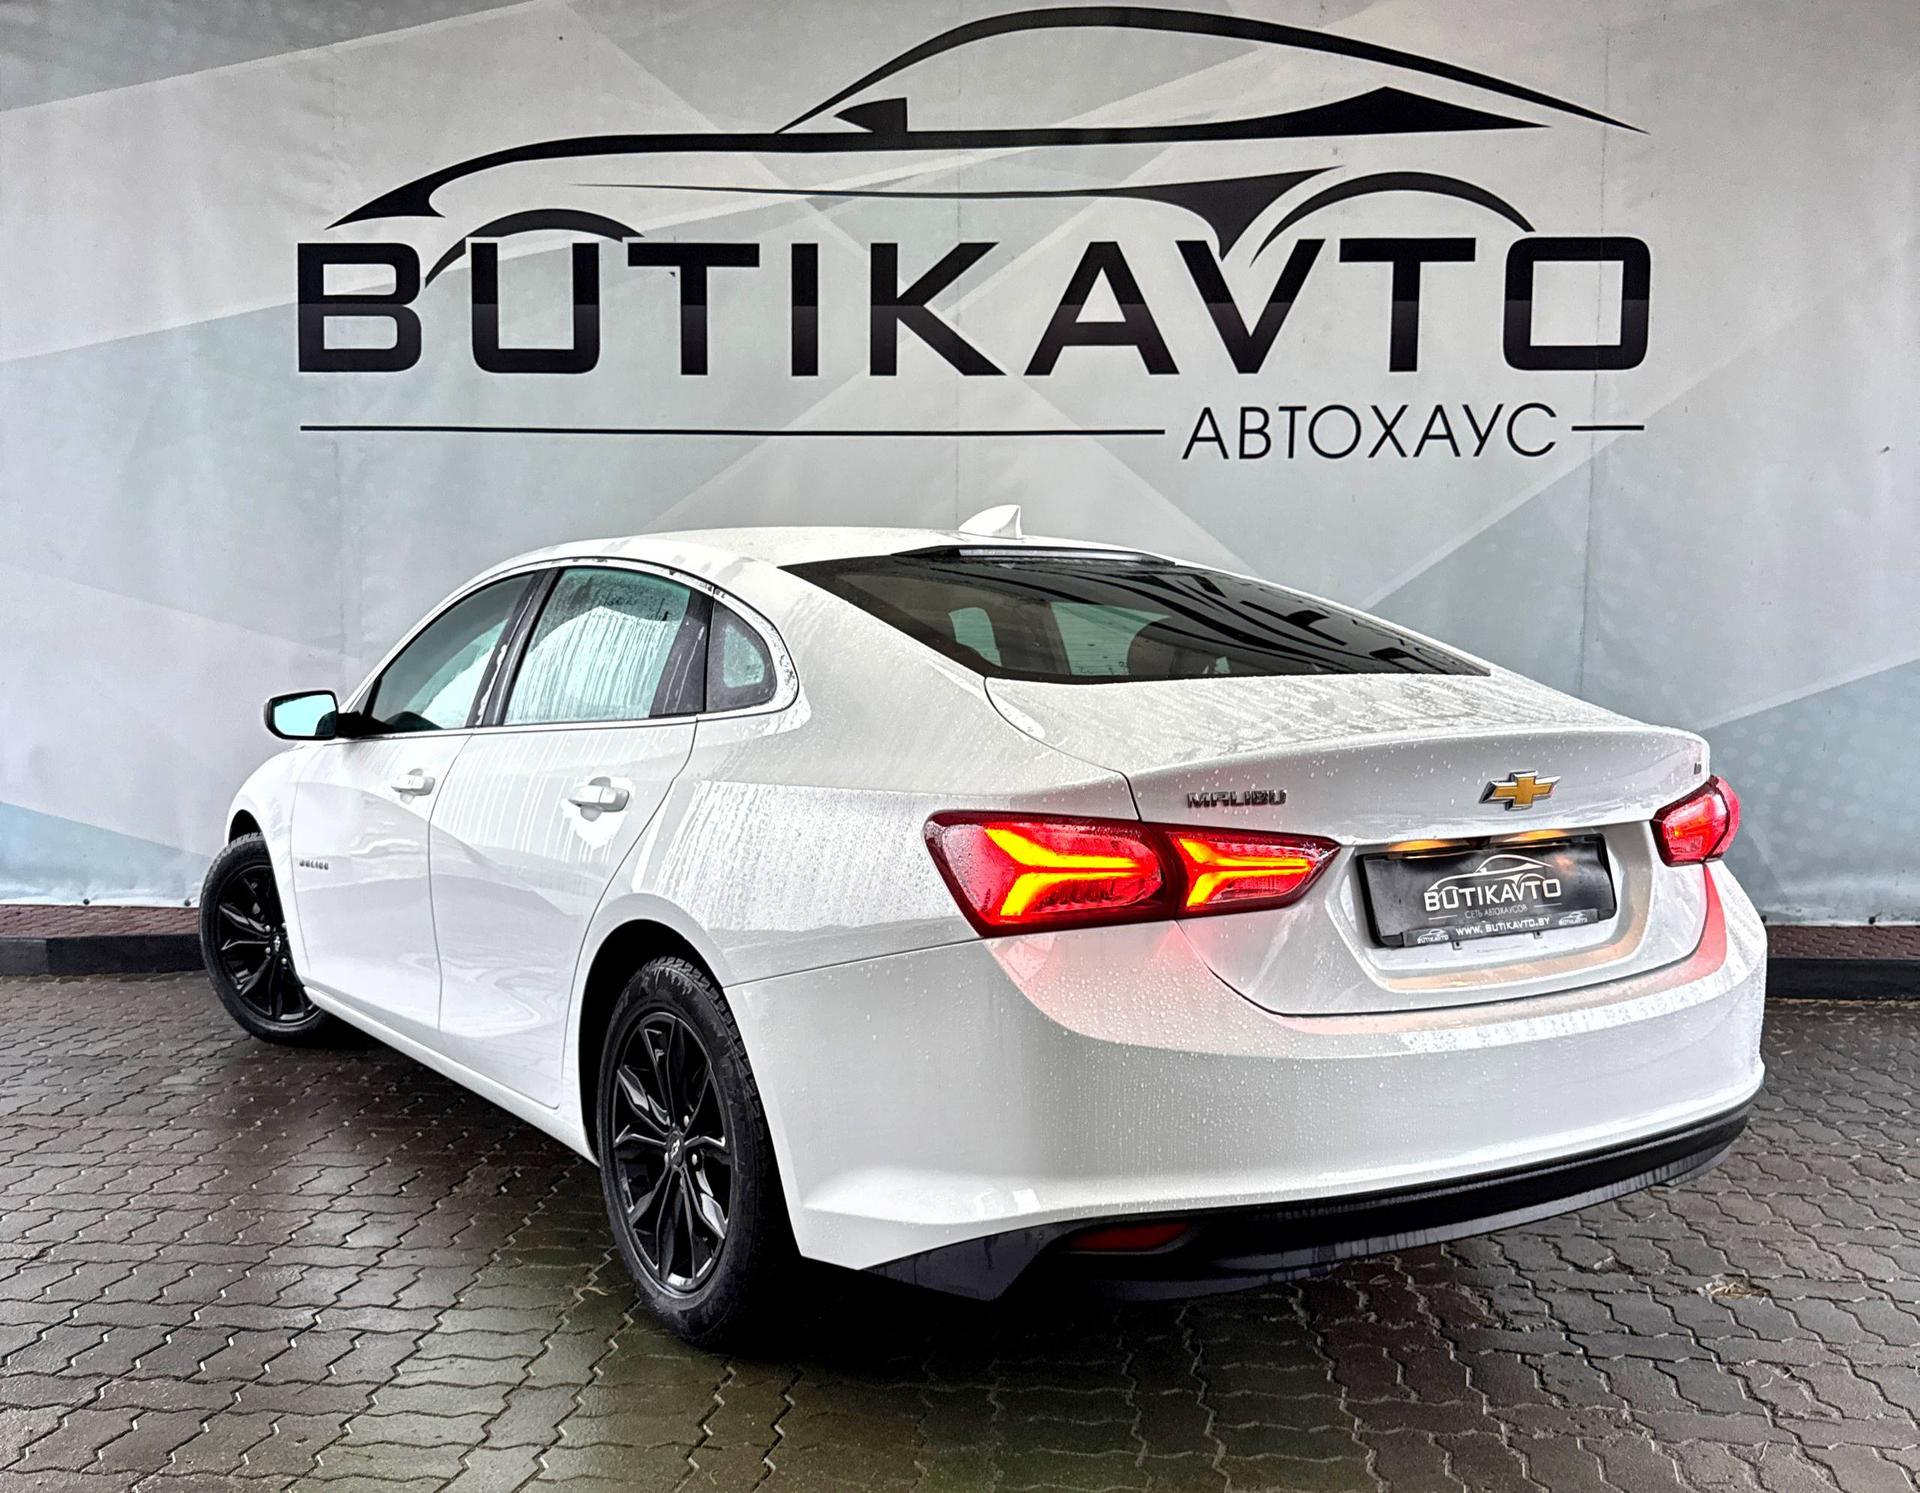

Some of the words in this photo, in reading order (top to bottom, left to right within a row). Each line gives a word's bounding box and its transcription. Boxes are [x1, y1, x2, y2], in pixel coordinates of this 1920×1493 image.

[298, 237, 1651, 376] BUTIKAVTO
[1182, 403, 1557, 460] АВТОХАУС
[1187, 790, 1287, 808] MALIBU
[1424, 879, 1562, 912] BUTIKAVTO
[1464, 909, 1483, 919] СЕТЬ
